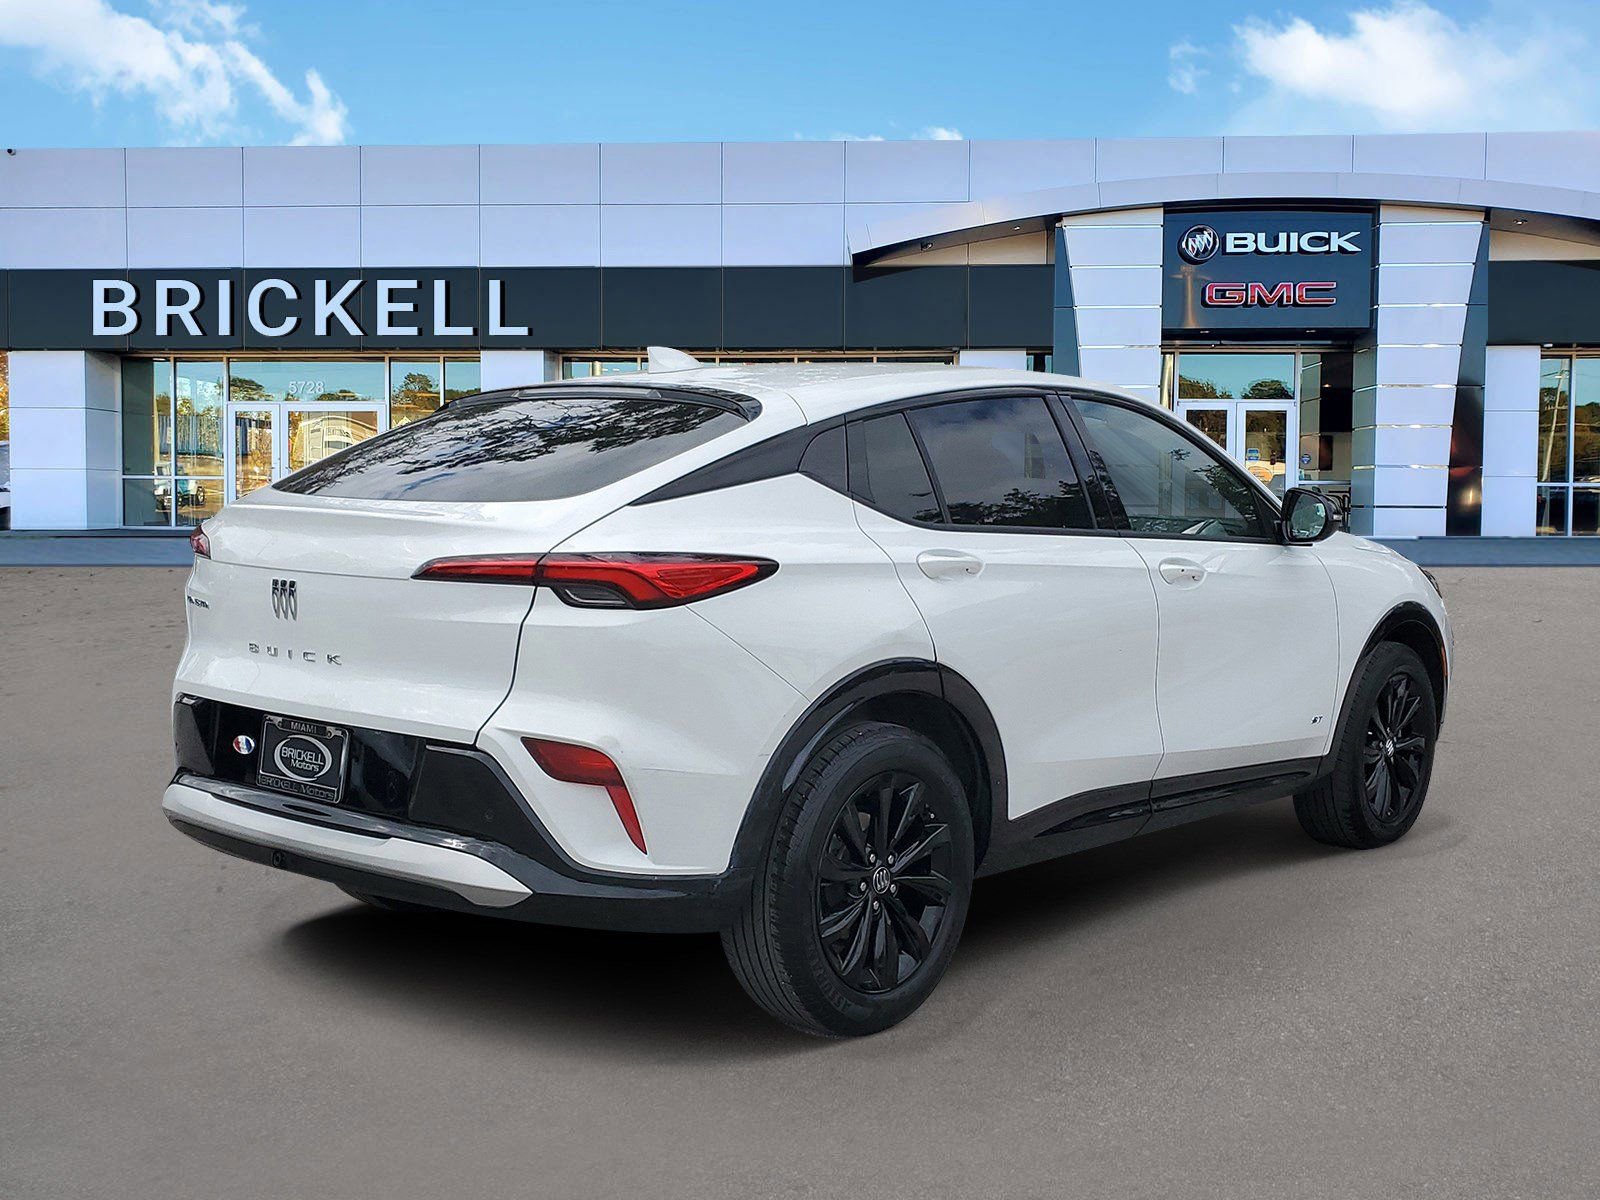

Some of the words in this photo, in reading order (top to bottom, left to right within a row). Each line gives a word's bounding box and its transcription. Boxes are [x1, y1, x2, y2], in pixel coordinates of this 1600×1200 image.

[1225, 231, 1362, 253] BUICK
[1205, 282, 1338, 305] GMC
[91, 278, 531, 337] BRICKELL
[288, 380, 326, 395] 5728
[248, 642, 343, 666] BUICK
[290, 721, 317, 734] MIAMI
[281, 746, 325, 766] BRICKELL
[290, 759, 320, 773] Motors
